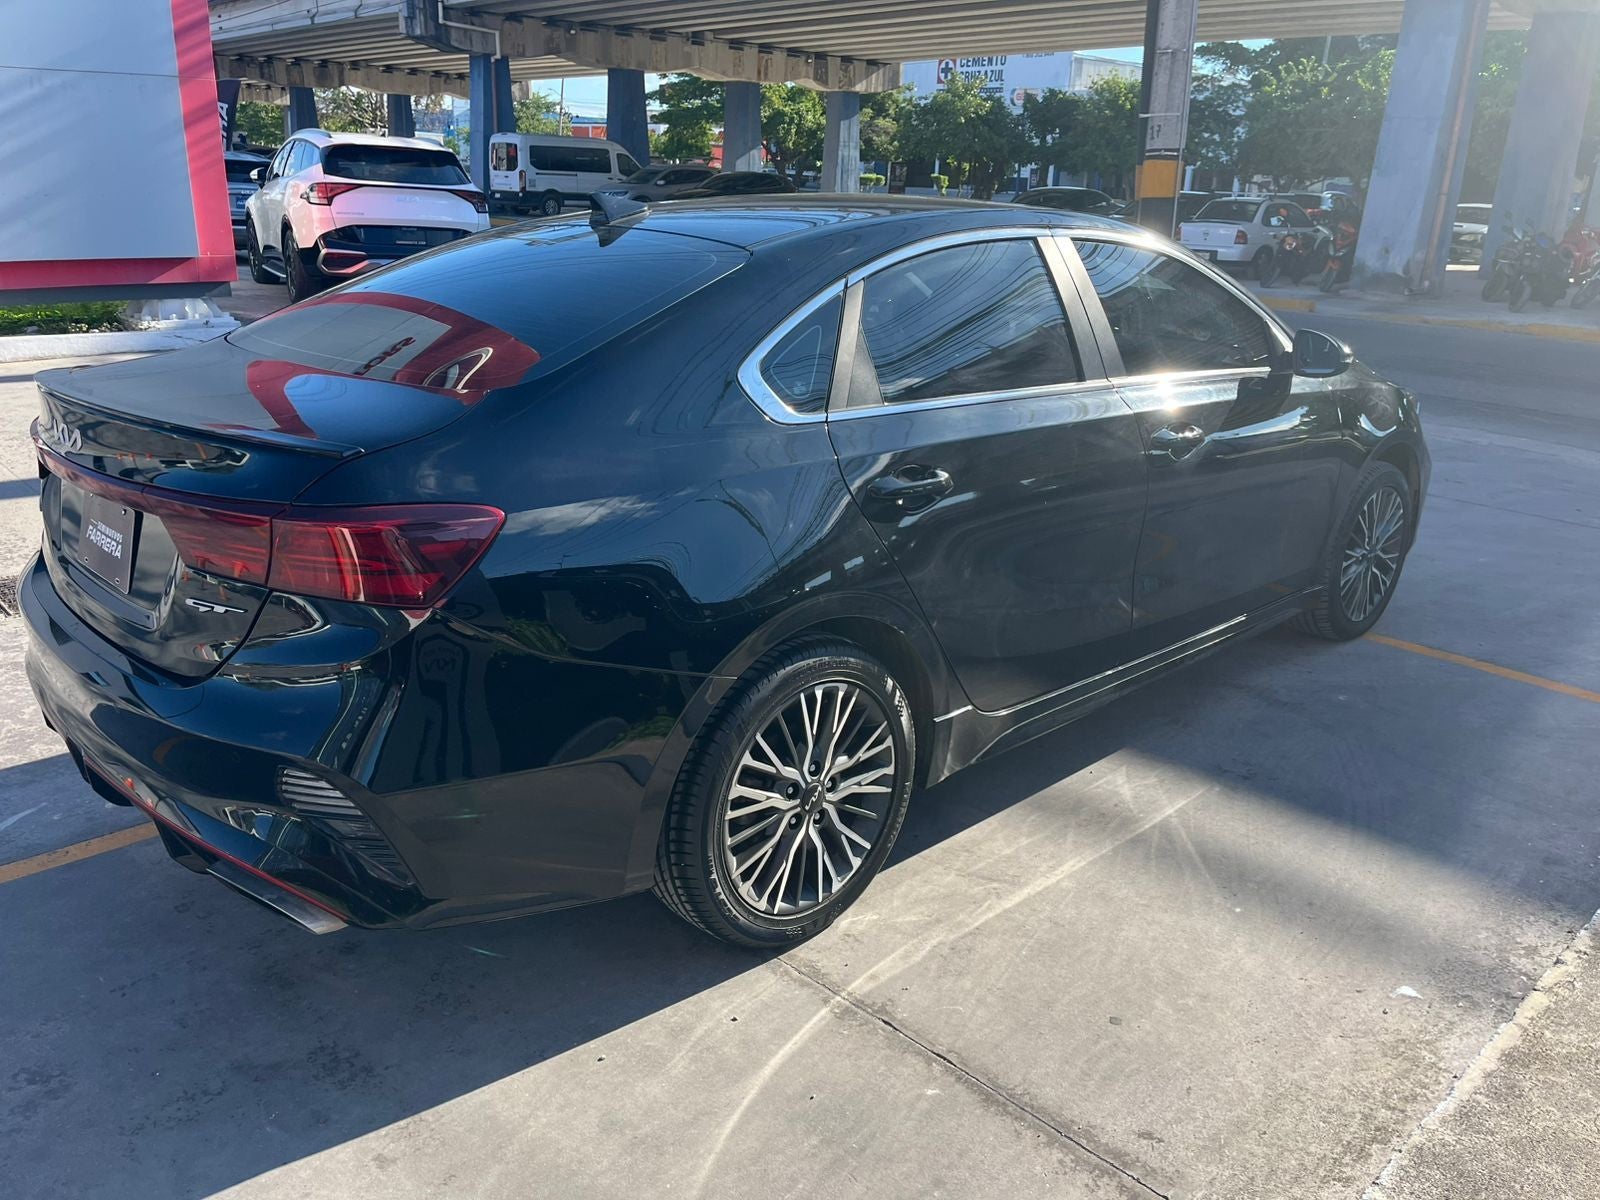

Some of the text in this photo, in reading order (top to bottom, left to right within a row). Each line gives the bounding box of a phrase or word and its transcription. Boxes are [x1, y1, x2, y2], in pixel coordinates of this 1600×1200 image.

[960, 55, 1007, 68] CEMENTO
[983, 69, 1004, 82] AZUL
[53, 418, 82, 451] KIA
[86, 524, 122, 559] FARRERA
[185, 598, 245, 613] GT
